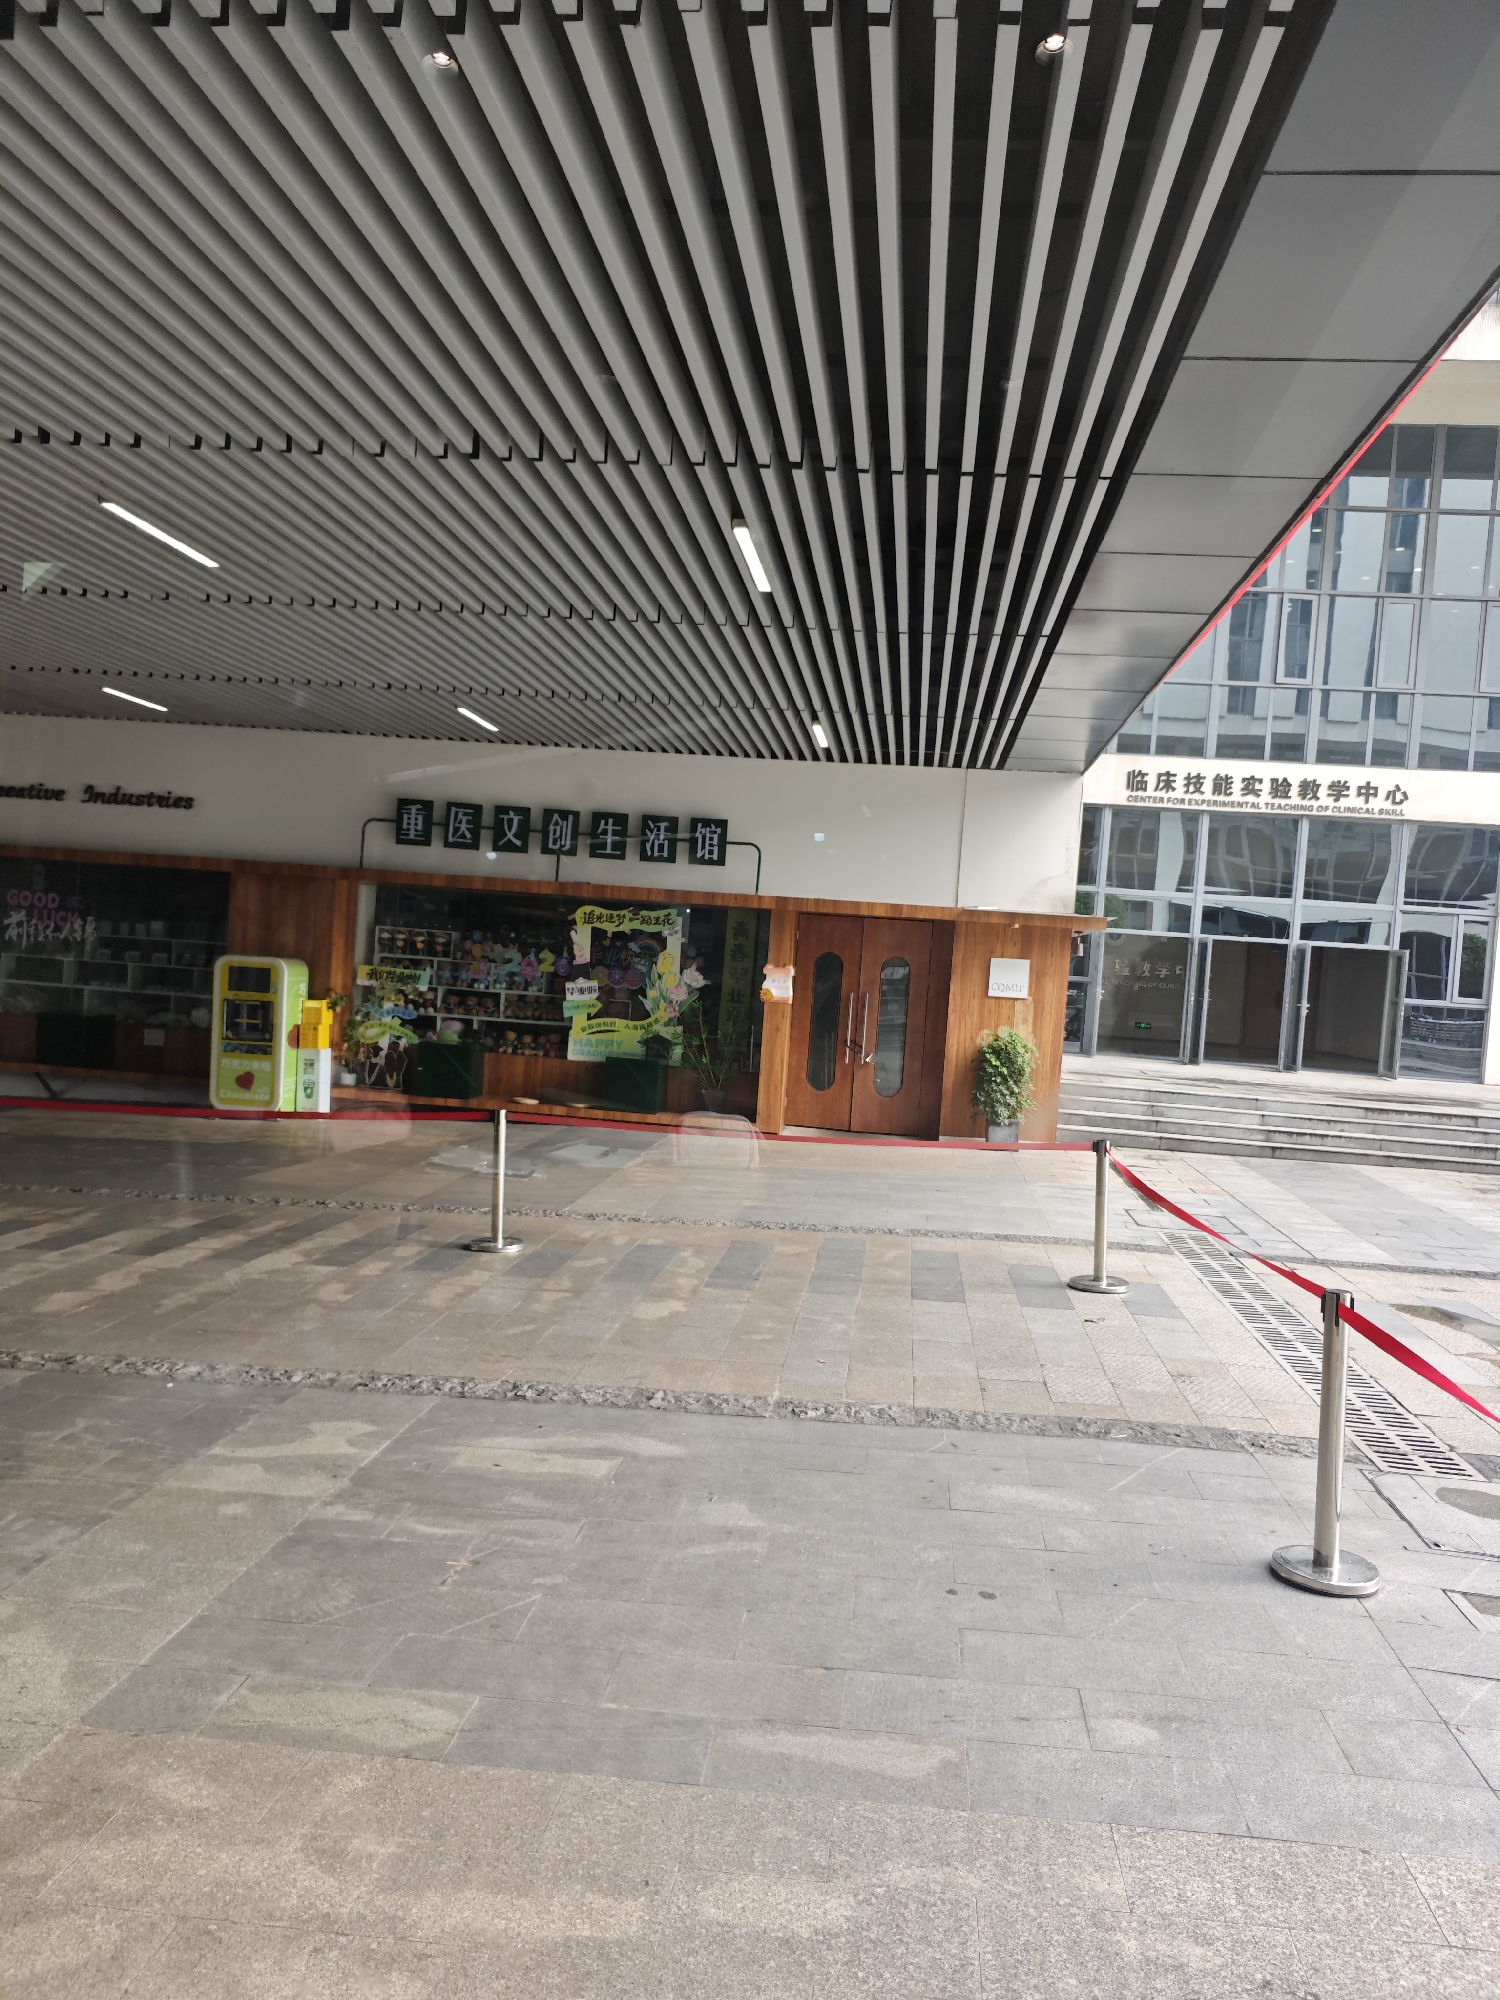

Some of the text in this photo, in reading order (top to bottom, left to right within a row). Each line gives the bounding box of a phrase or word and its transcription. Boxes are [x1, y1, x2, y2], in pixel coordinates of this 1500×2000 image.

[1126, 769, 1410, 806] 临床技能实验教学中心
[81, 785, 194, 810] Industries
[1127, 795, 1406, 817] CENTER FOR EXPERIMENTAL TEACHING OF CLINICAL SKILL
[399, 804, 722, 861] 重医文创生活馆
[6, 889, 60, 908] GOOD
[33, 908, 80, 927] LUCK
[582, 909, 675, 927] 追光逐梦 一路生花
[991, 982, 1022, 993] CQMU
[573, 1037, 624, 1050] HAPPY
[219, 1089, 271, 1101] Chocolate
